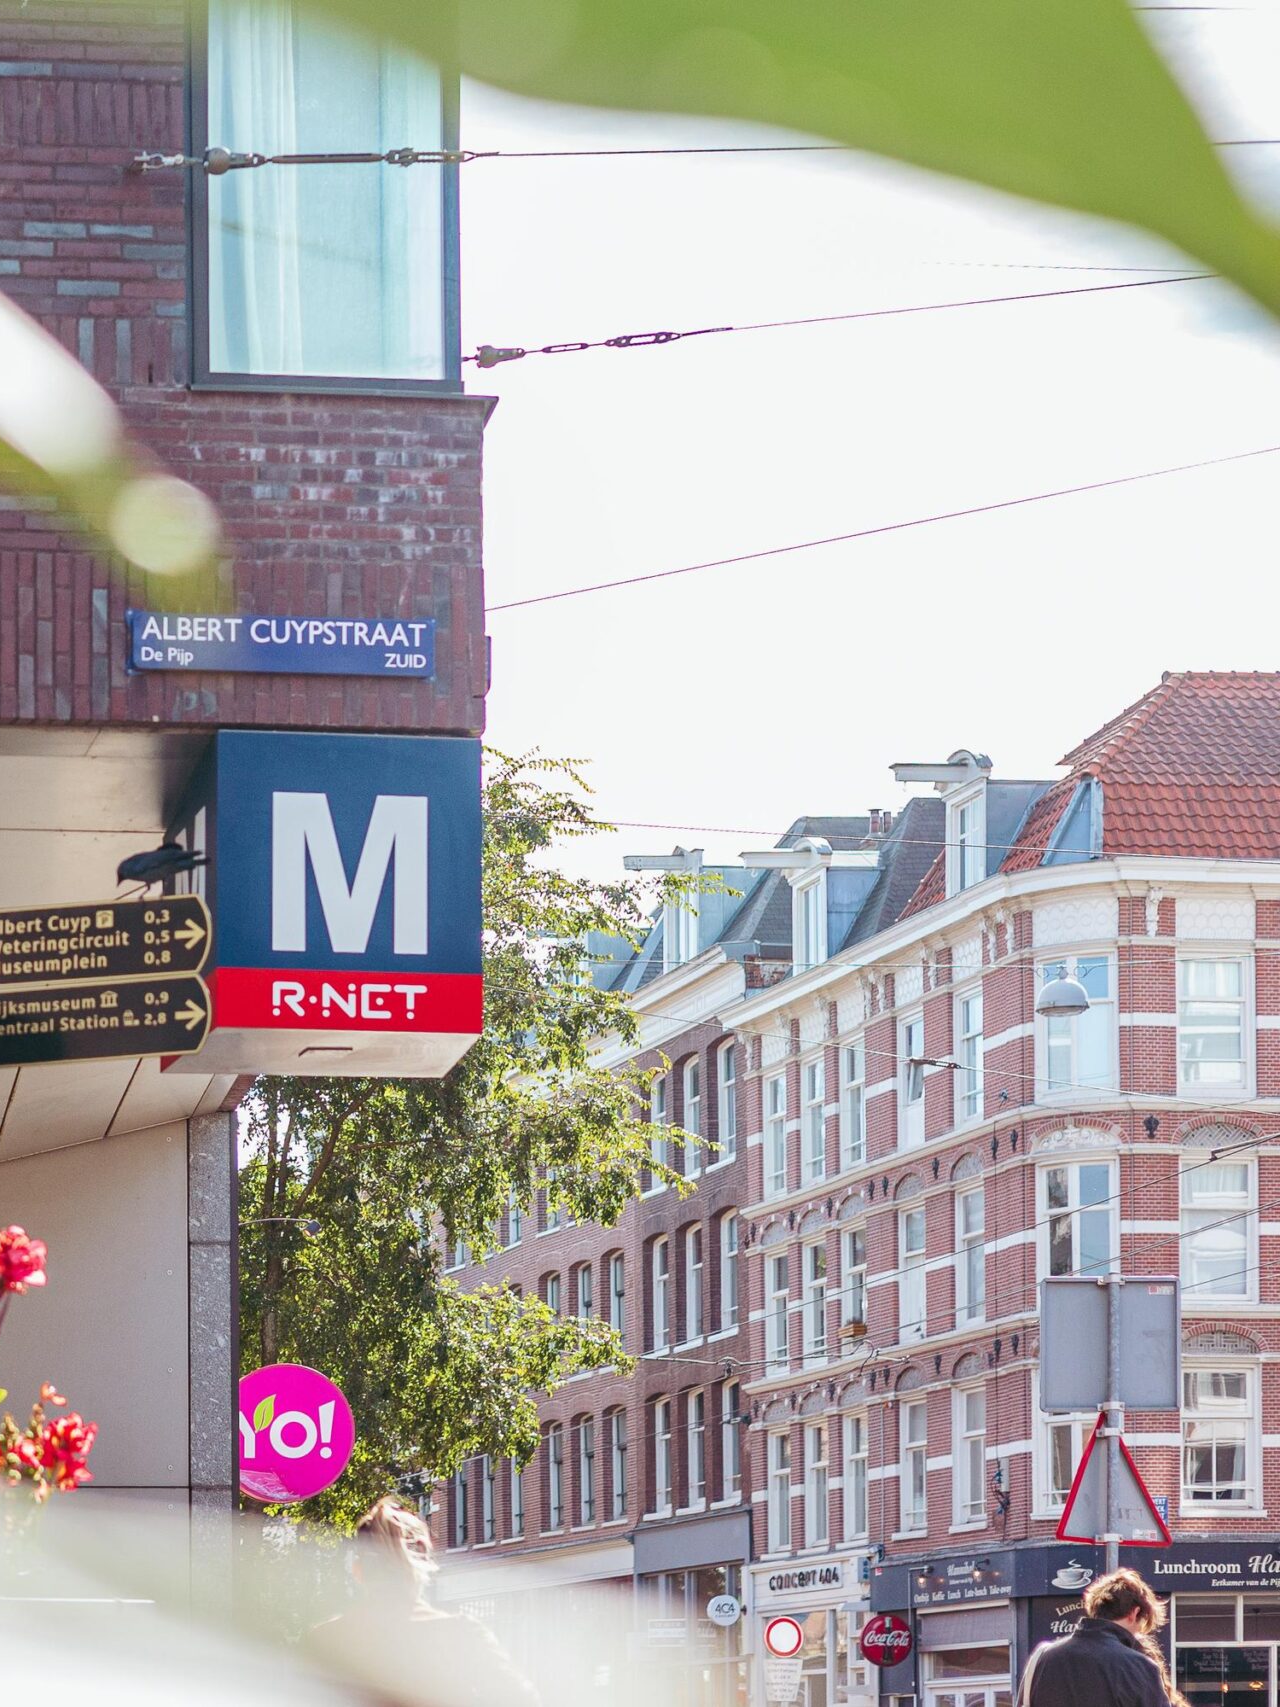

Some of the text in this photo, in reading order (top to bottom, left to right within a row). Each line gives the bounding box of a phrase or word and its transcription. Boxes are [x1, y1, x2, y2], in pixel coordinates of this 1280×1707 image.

[141, 616, 427, 647] ALBERT CUYPSTRAAT
[140, 647, 194, 667] De Pijp
[385, 653, 427, 669] ZUID
[272, 791, 428, 955] M
[47, 915, 91, 933] Cuyp
[144, 910, 170, 924] 0,3
[144, 930, 170, 945] 0,5
[144, 950, 171, 965] 0,8
[144, 991, 170, 1006] 0,9
[60, 1013, 119, 1032] Station
[144, 1012, 167, 1026] 2,8
[819, 1566, 839, 1584] 404
[1153, 1559, 1241, 1574] Lunchroom
[1211, 1579, 1245, 1587] Eetkamer
[1260, 1578, 1269, 1586] de
